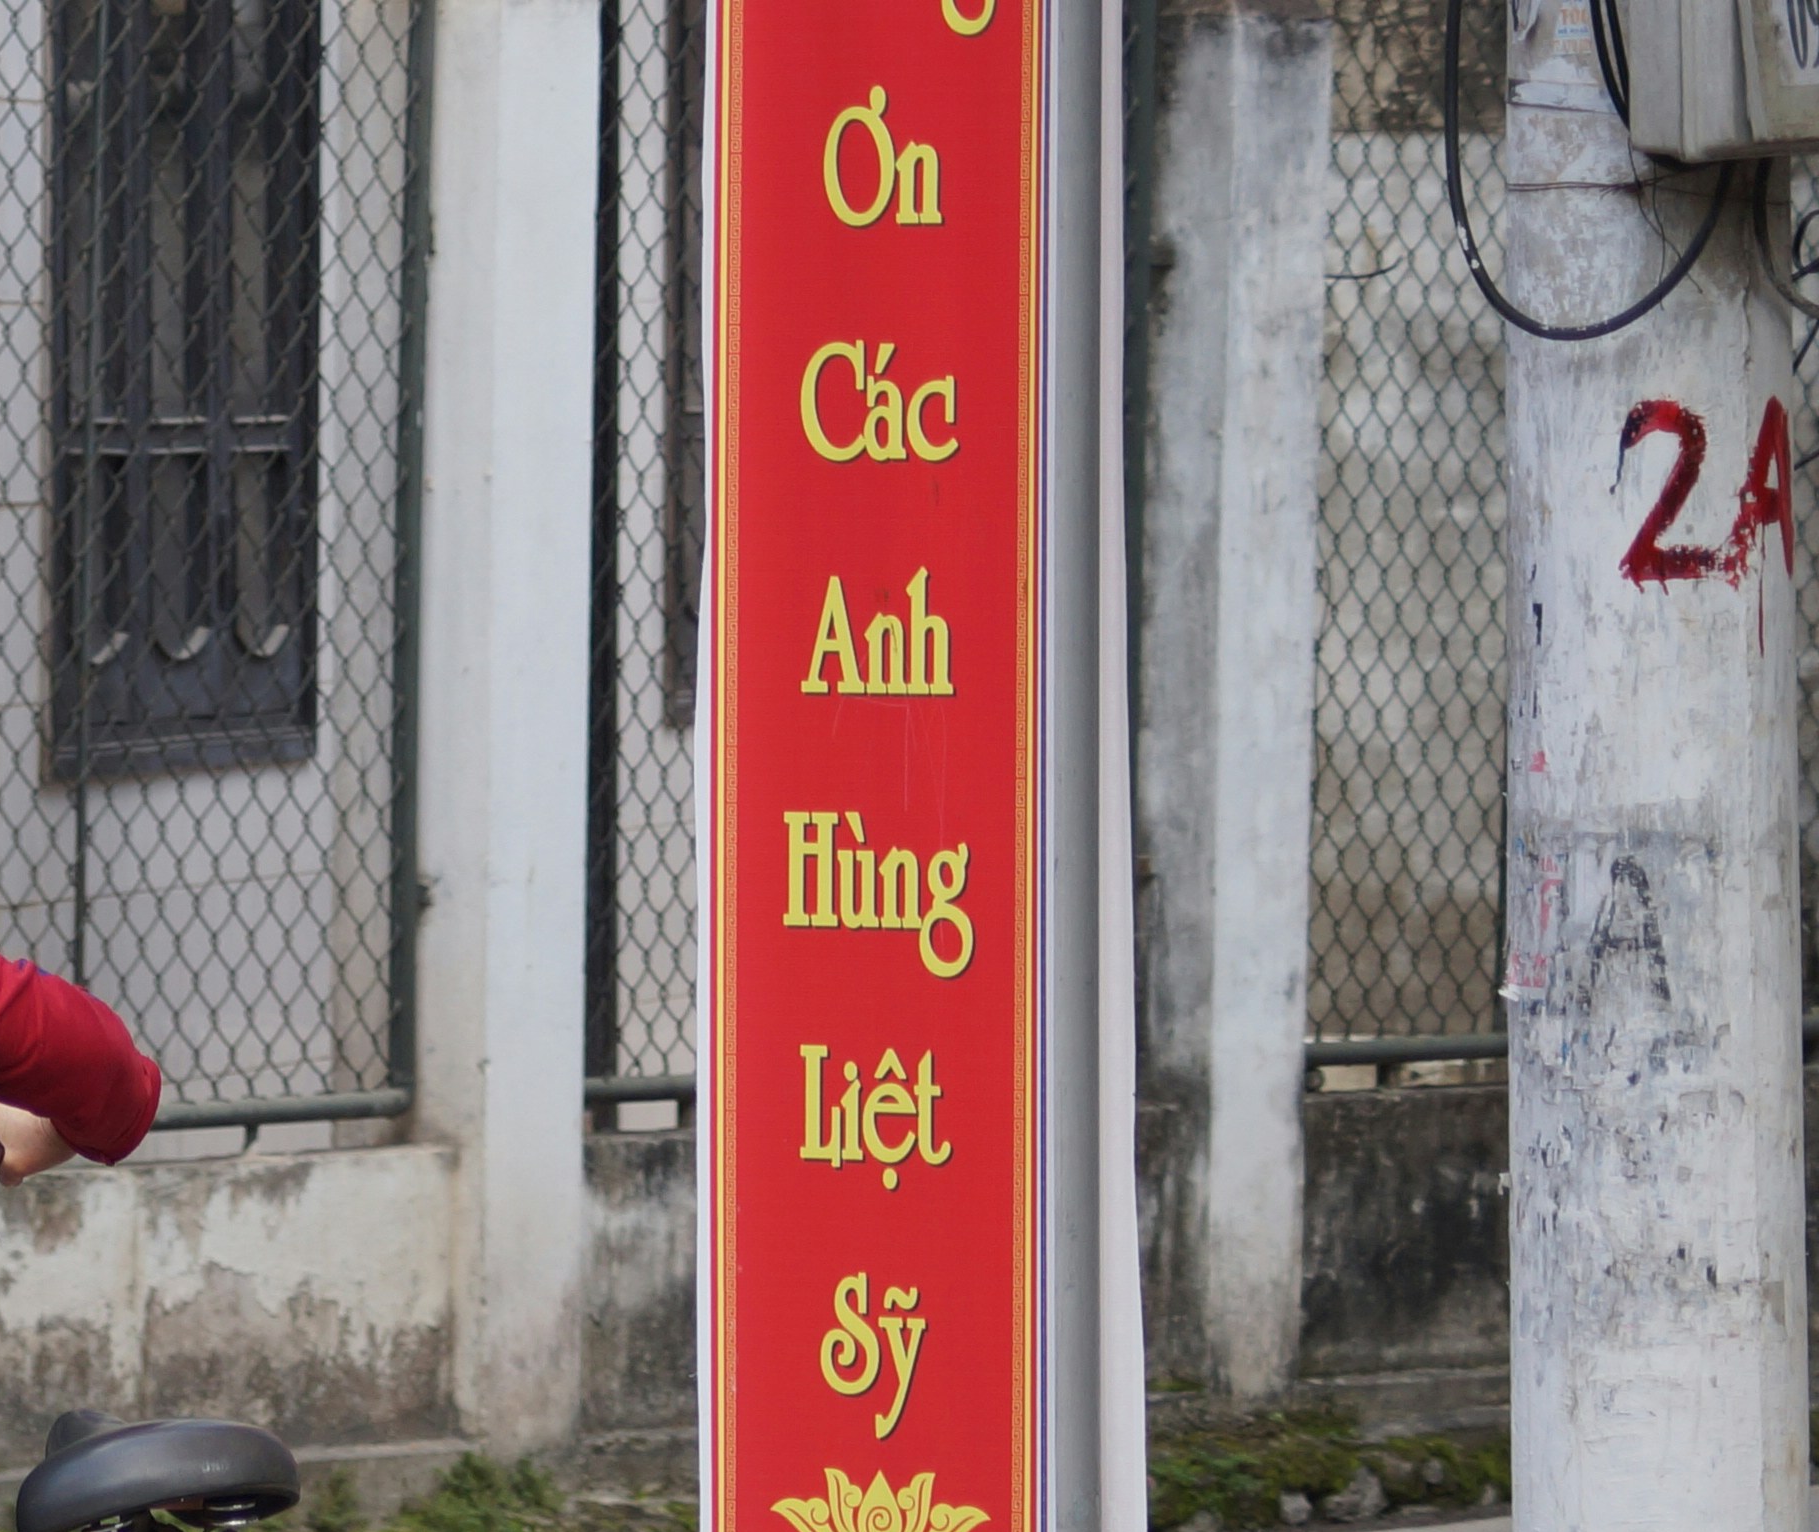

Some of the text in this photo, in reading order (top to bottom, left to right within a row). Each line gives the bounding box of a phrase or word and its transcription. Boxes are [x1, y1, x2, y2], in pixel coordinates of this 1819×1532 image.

[822, 84, 943, 227] Ơn
[799, 338, 960, 462] Các
[800, 565, 955, 696] Anh
[782, 810, 974, 979] Hùng
[799, 1043, 953, 1191] Liệt
[819, 1272, 927, 1440] Sỹ
